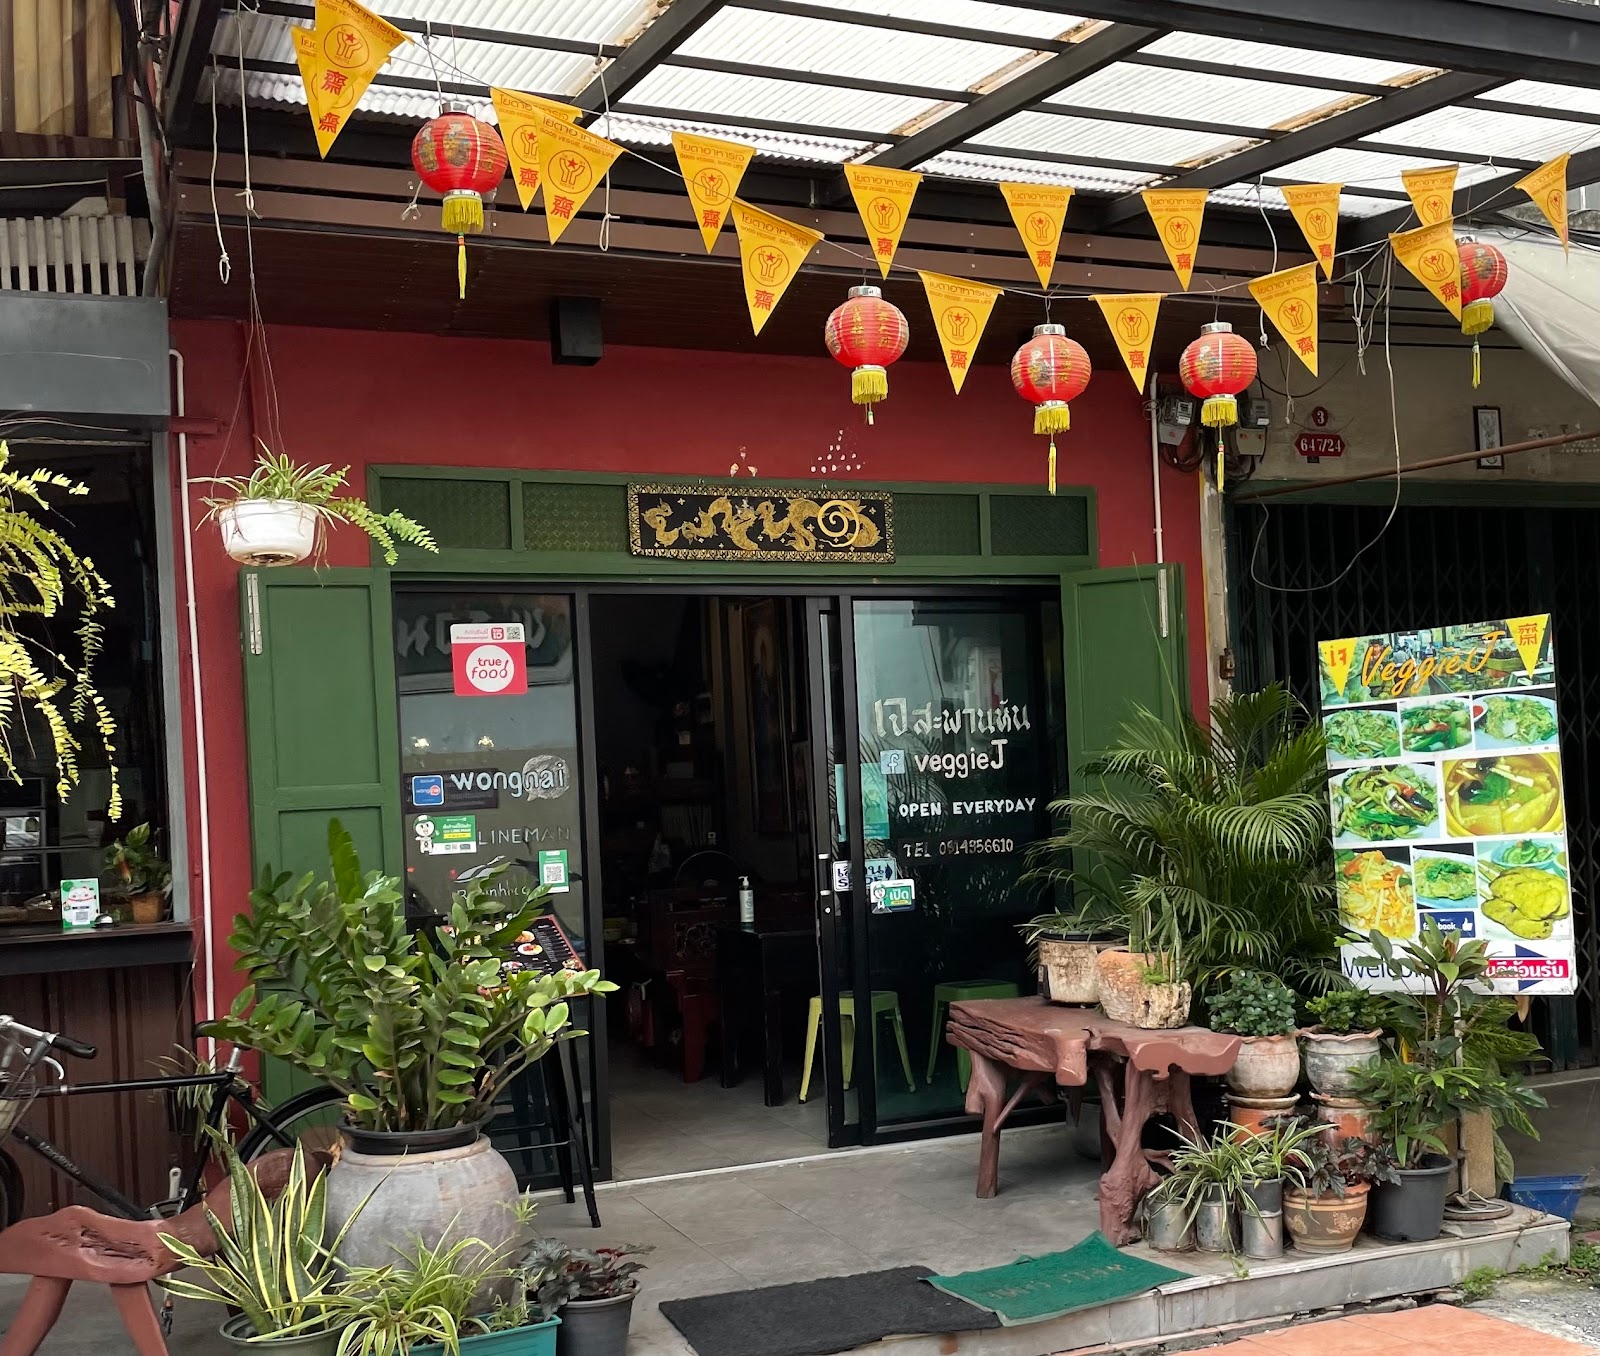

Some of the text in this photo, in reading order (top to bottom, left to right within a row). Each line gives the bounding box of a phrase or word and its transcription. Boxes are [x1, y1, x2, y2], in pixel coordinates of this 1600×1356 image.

[1316, 410, 1325, 424] 3
[1300, 439, 1341, 452] 647/24
[478, 657, 502, 666] true
[914, 739, 1009, 778] veggieJ
[450, 763, 565, 798] wongnai
[899, 798, 1036, 817] OPEN EVERYDAY
[903, 842, 932, 857] TEL
